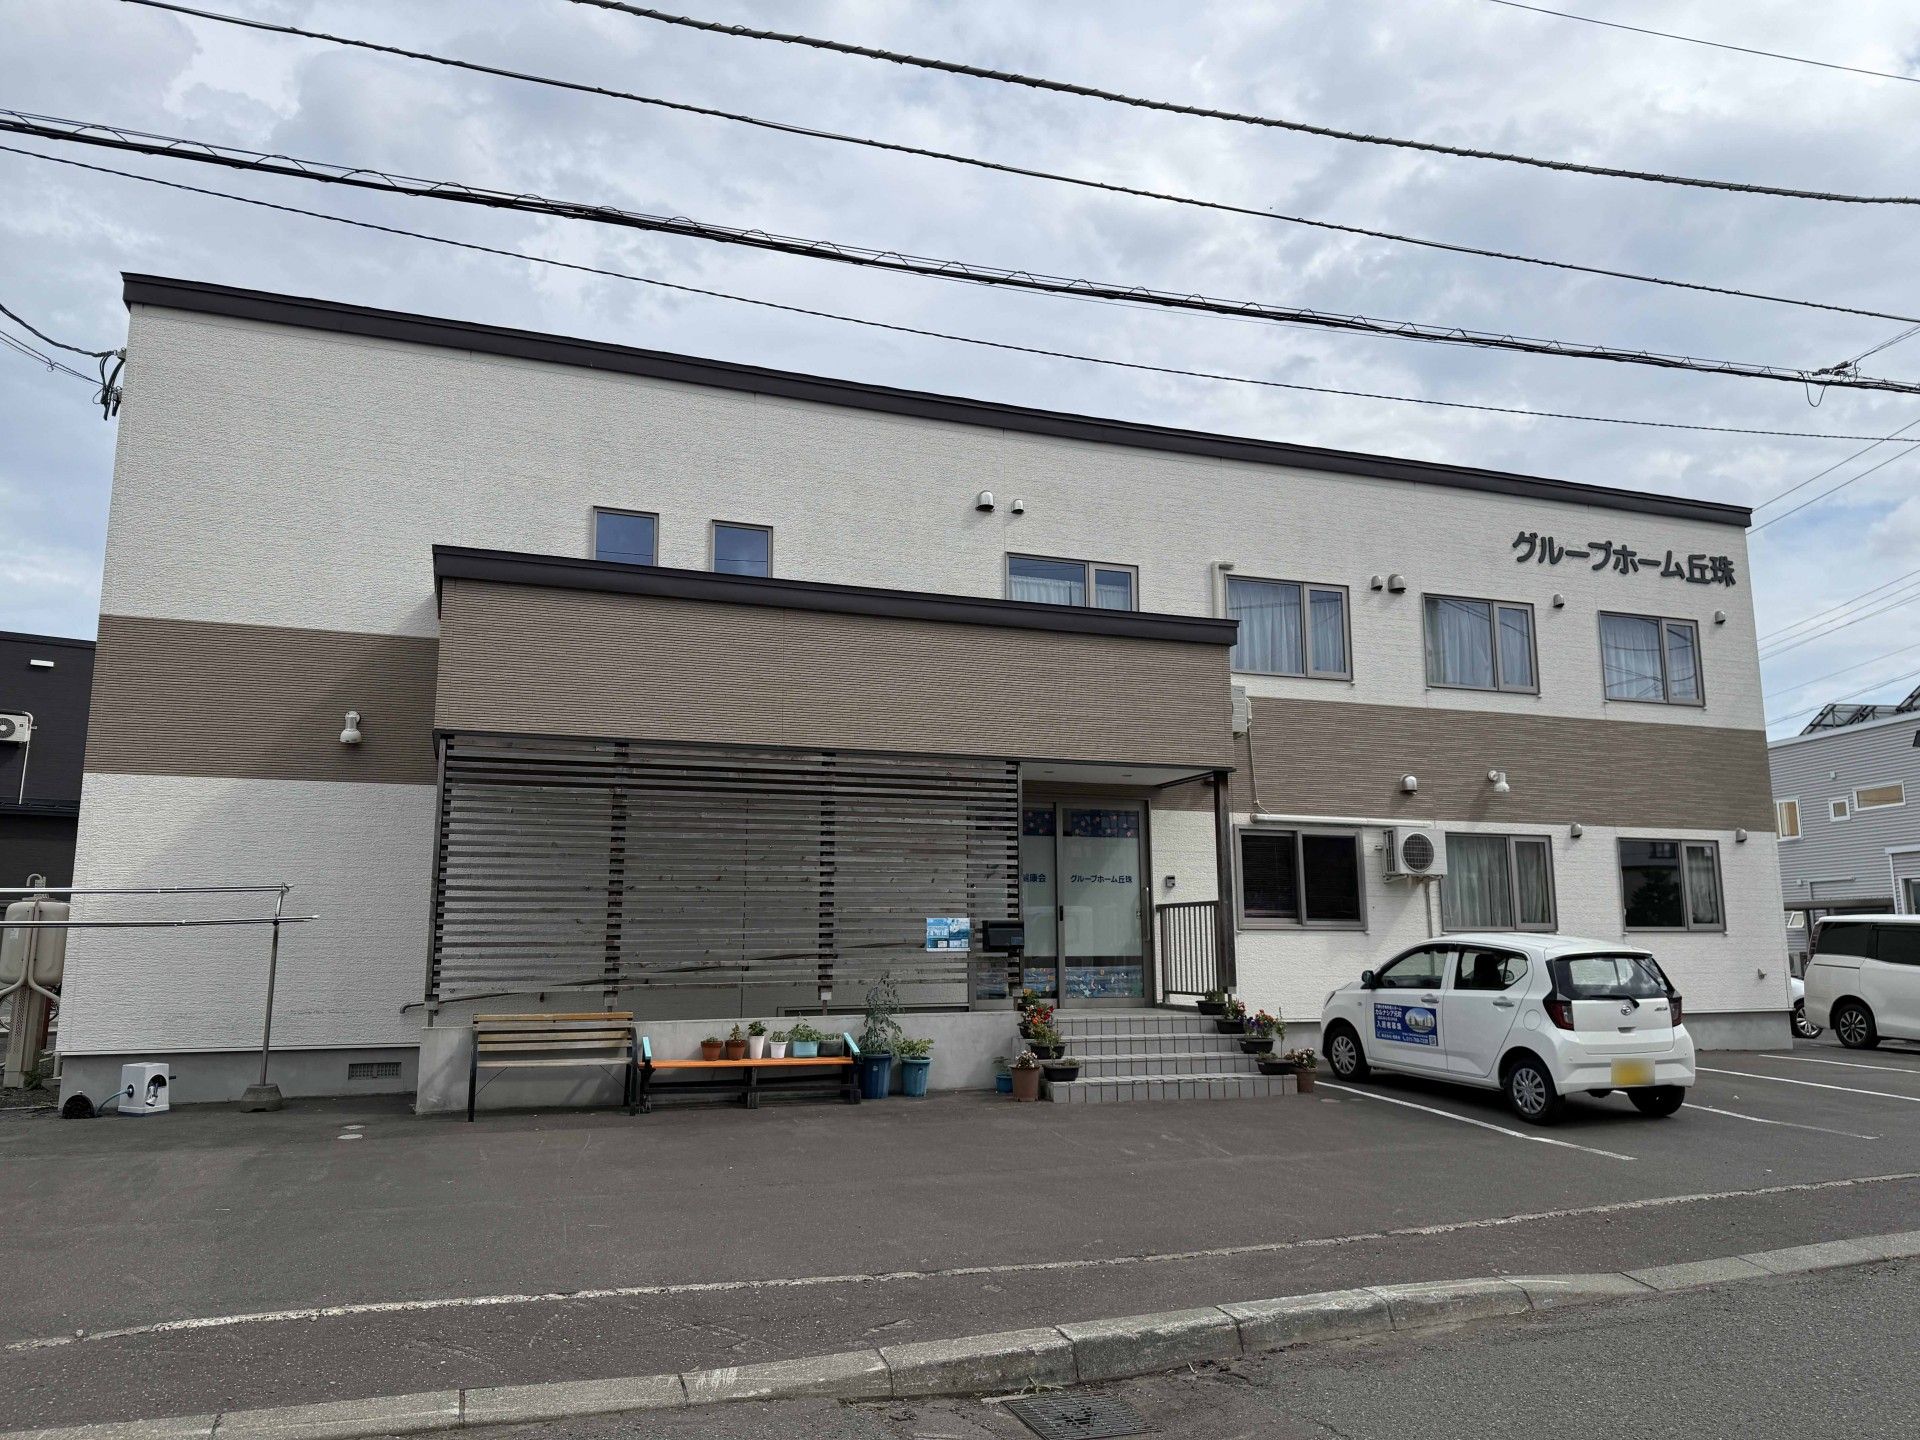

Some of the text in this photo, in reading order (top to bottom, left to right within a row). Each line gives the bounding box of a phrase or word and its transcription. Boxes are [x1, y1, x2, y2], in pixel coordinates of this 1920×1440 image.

[1512, 531, 1736, 587] グループホーム丘珠
[1070, 874, 1133, 884] グループホーム丘珠
